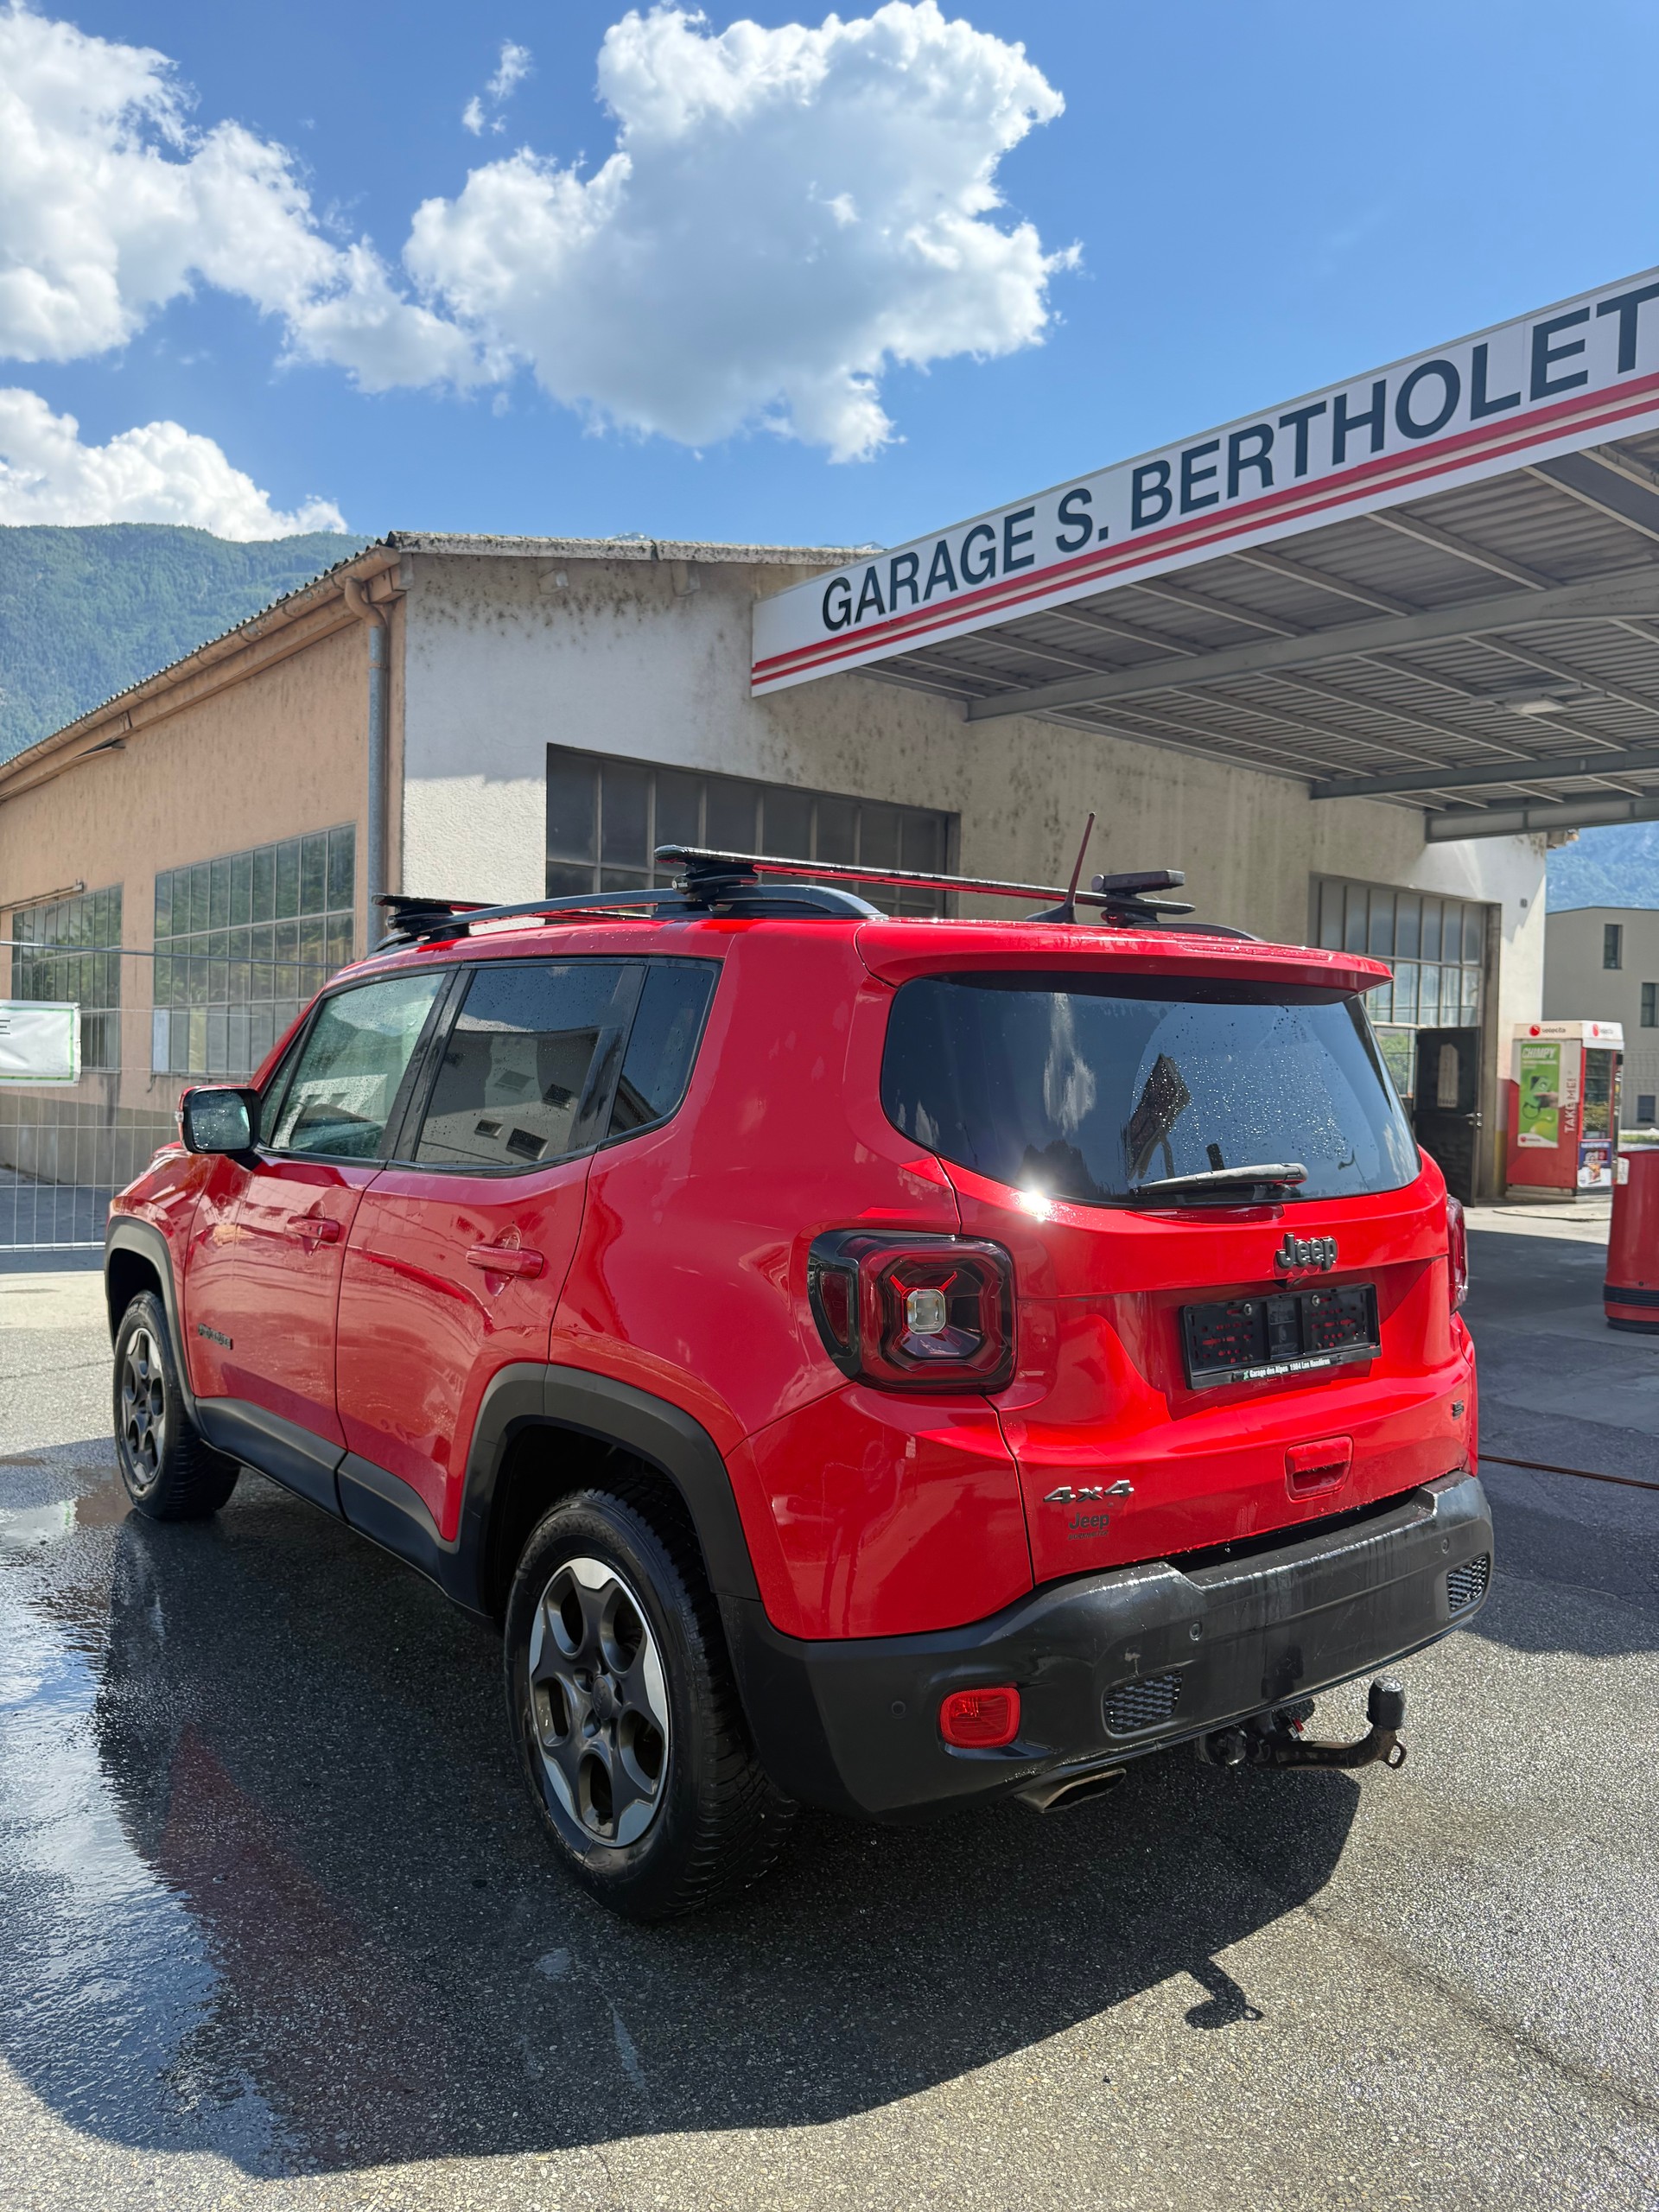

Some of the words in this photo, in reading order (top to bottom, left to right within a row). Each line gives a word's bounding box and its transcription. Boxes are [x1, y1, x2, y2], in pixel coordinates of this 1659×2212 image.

[823, 506, 1035, 631] GARAGE
[1056, 488, 1109, 553] S.
[1131, 283, 1659, 531] BERTHOLET
[1522, 1046, 1556, 1059] CHIMPY
[1564, 1103, 1577, 1134] TAKE
[1275, 1232, 1338, 1271] Jeep
[1249, 1368, 1267, 1378] Garage
[1275, 1365, 1289, 1374] Alpes
[1043, 1479, 1135, 1503] 4x4
[1068, 1512, 1109, 1529] Jeep
